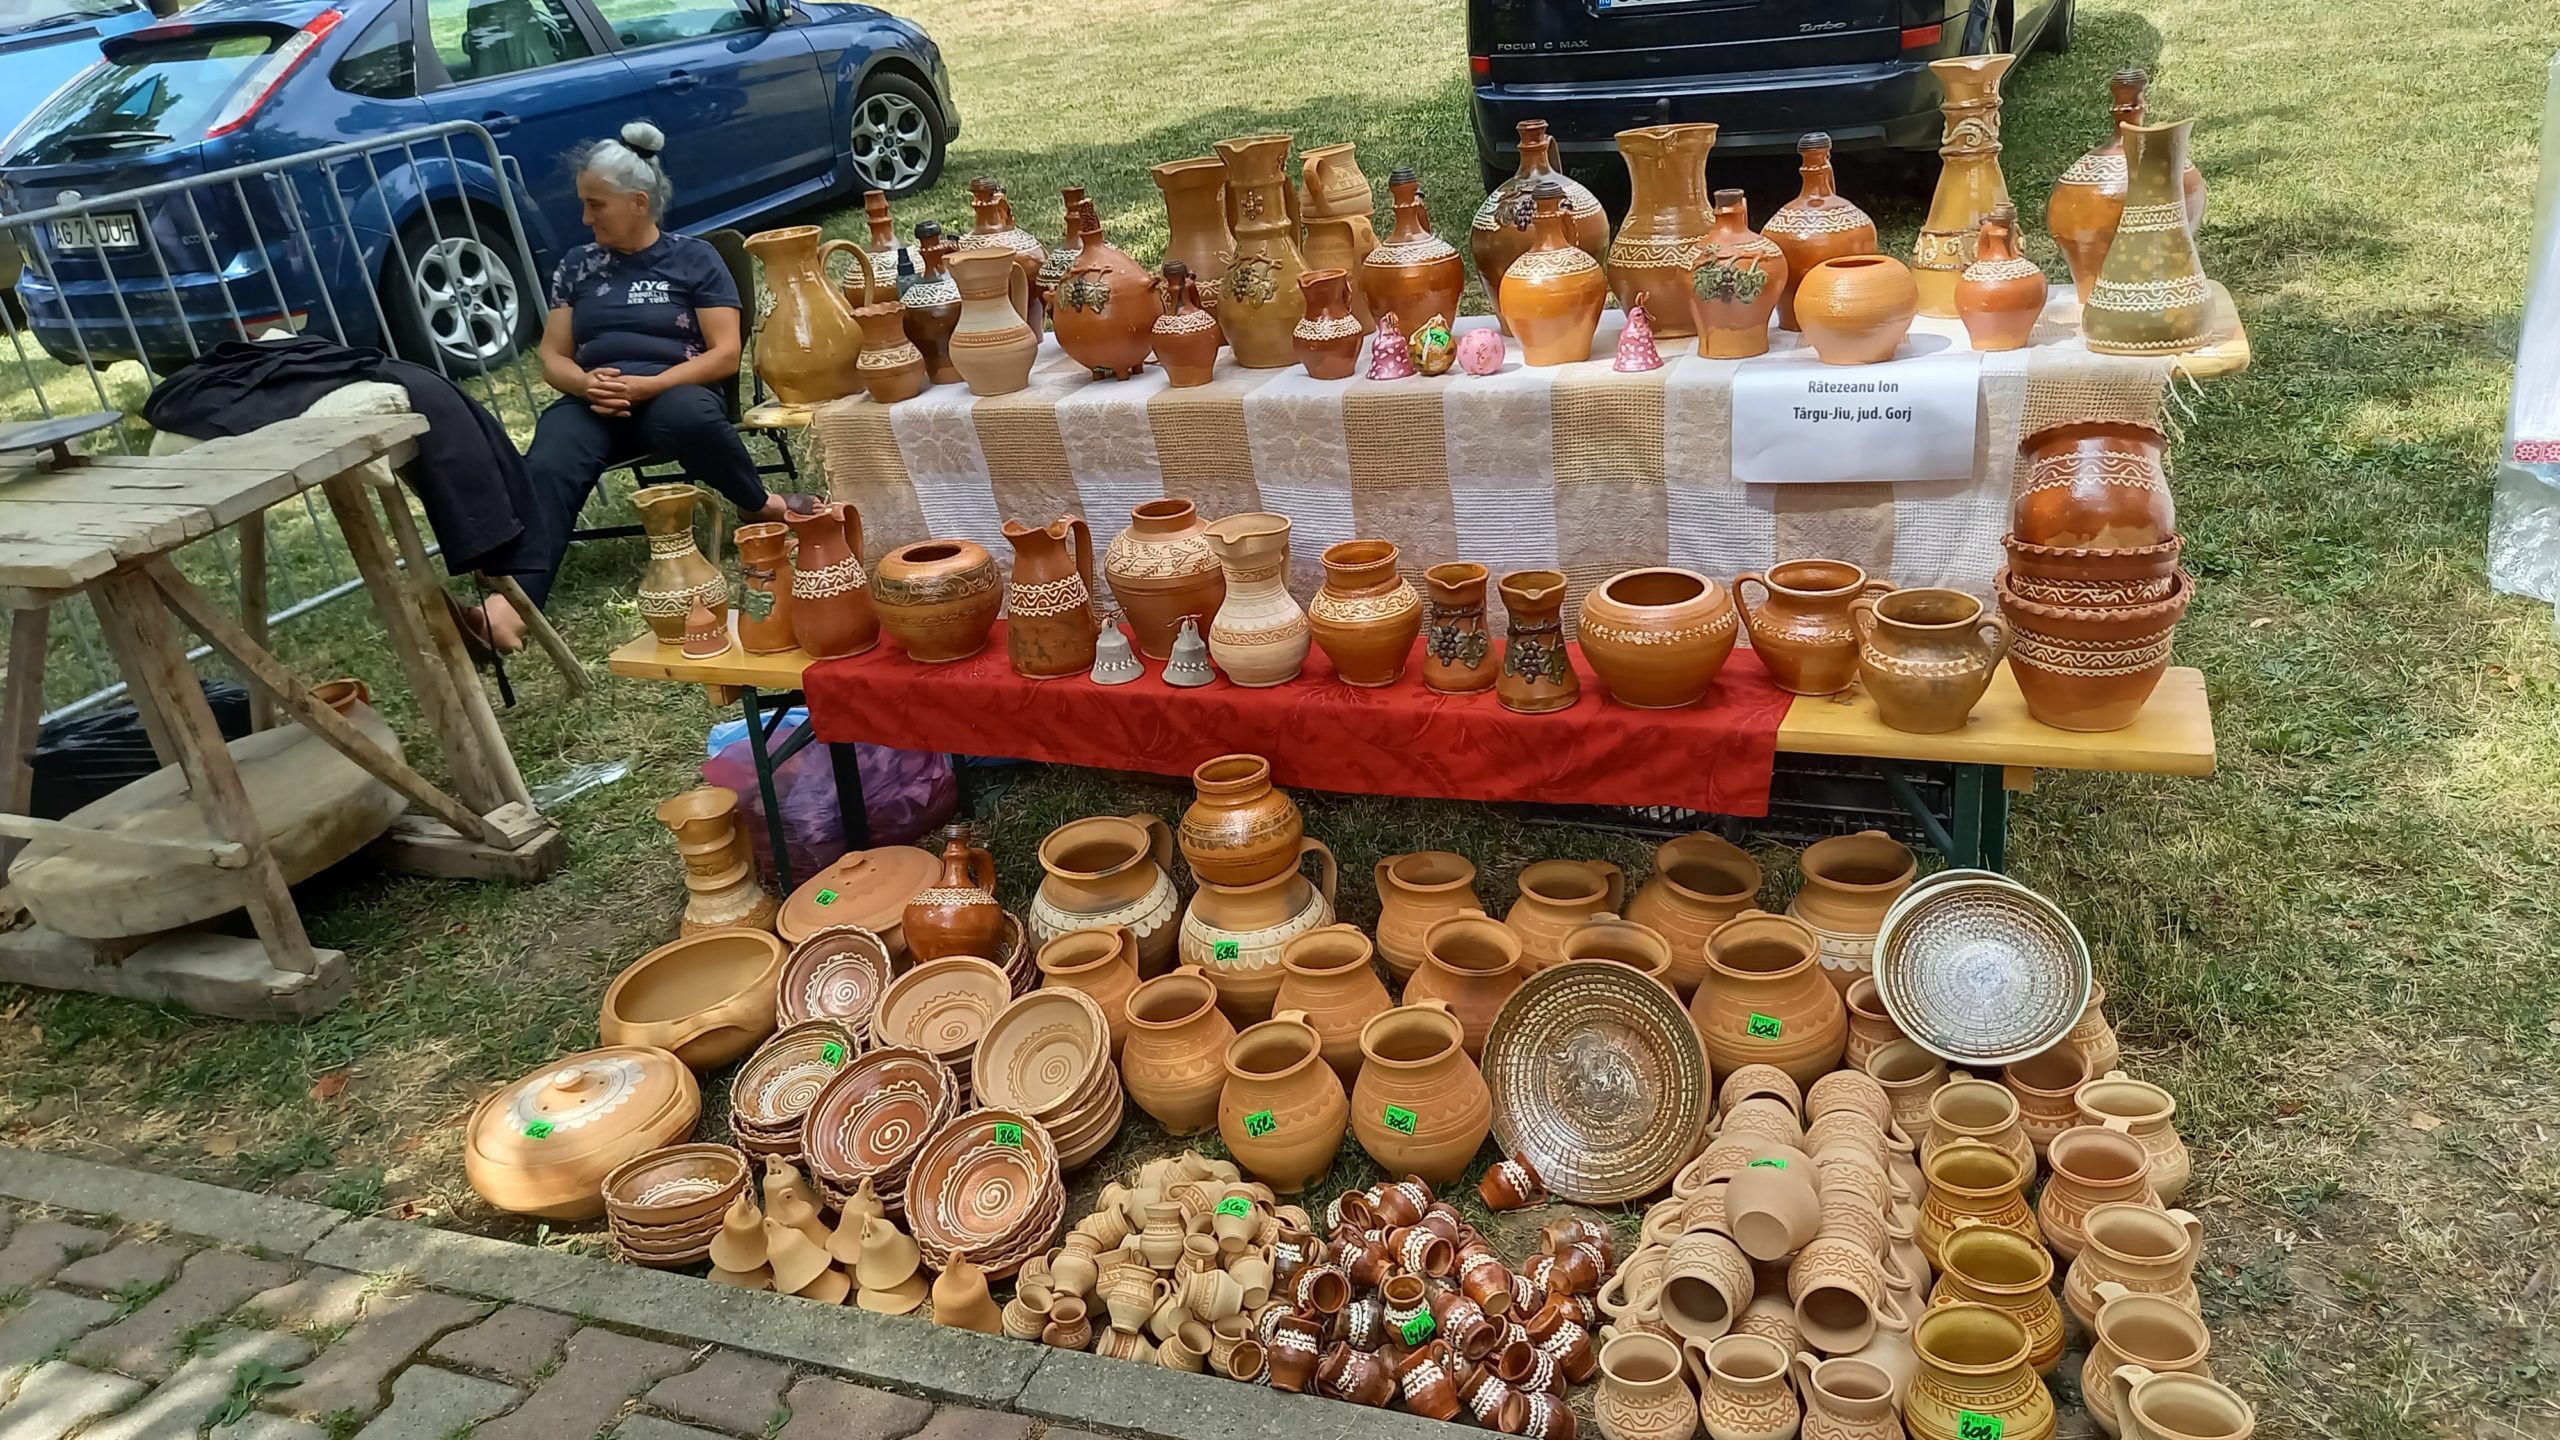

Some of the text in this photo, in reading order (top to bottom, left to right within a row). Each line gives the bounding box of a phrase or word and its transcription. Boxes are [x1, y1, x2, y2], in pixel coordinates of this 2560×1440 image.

[1800, 20, 1847, 32] Turbo
[1498, 40, 1589, 50] FOCUS C MAX
[54, 221, 73, 245] AG
[95, 217, 136, 244] DUH
[1878, 380, 1899, 393] Ion
[1793, 406, 1912, 423] Târgu-Jiu, jud. Gorj
